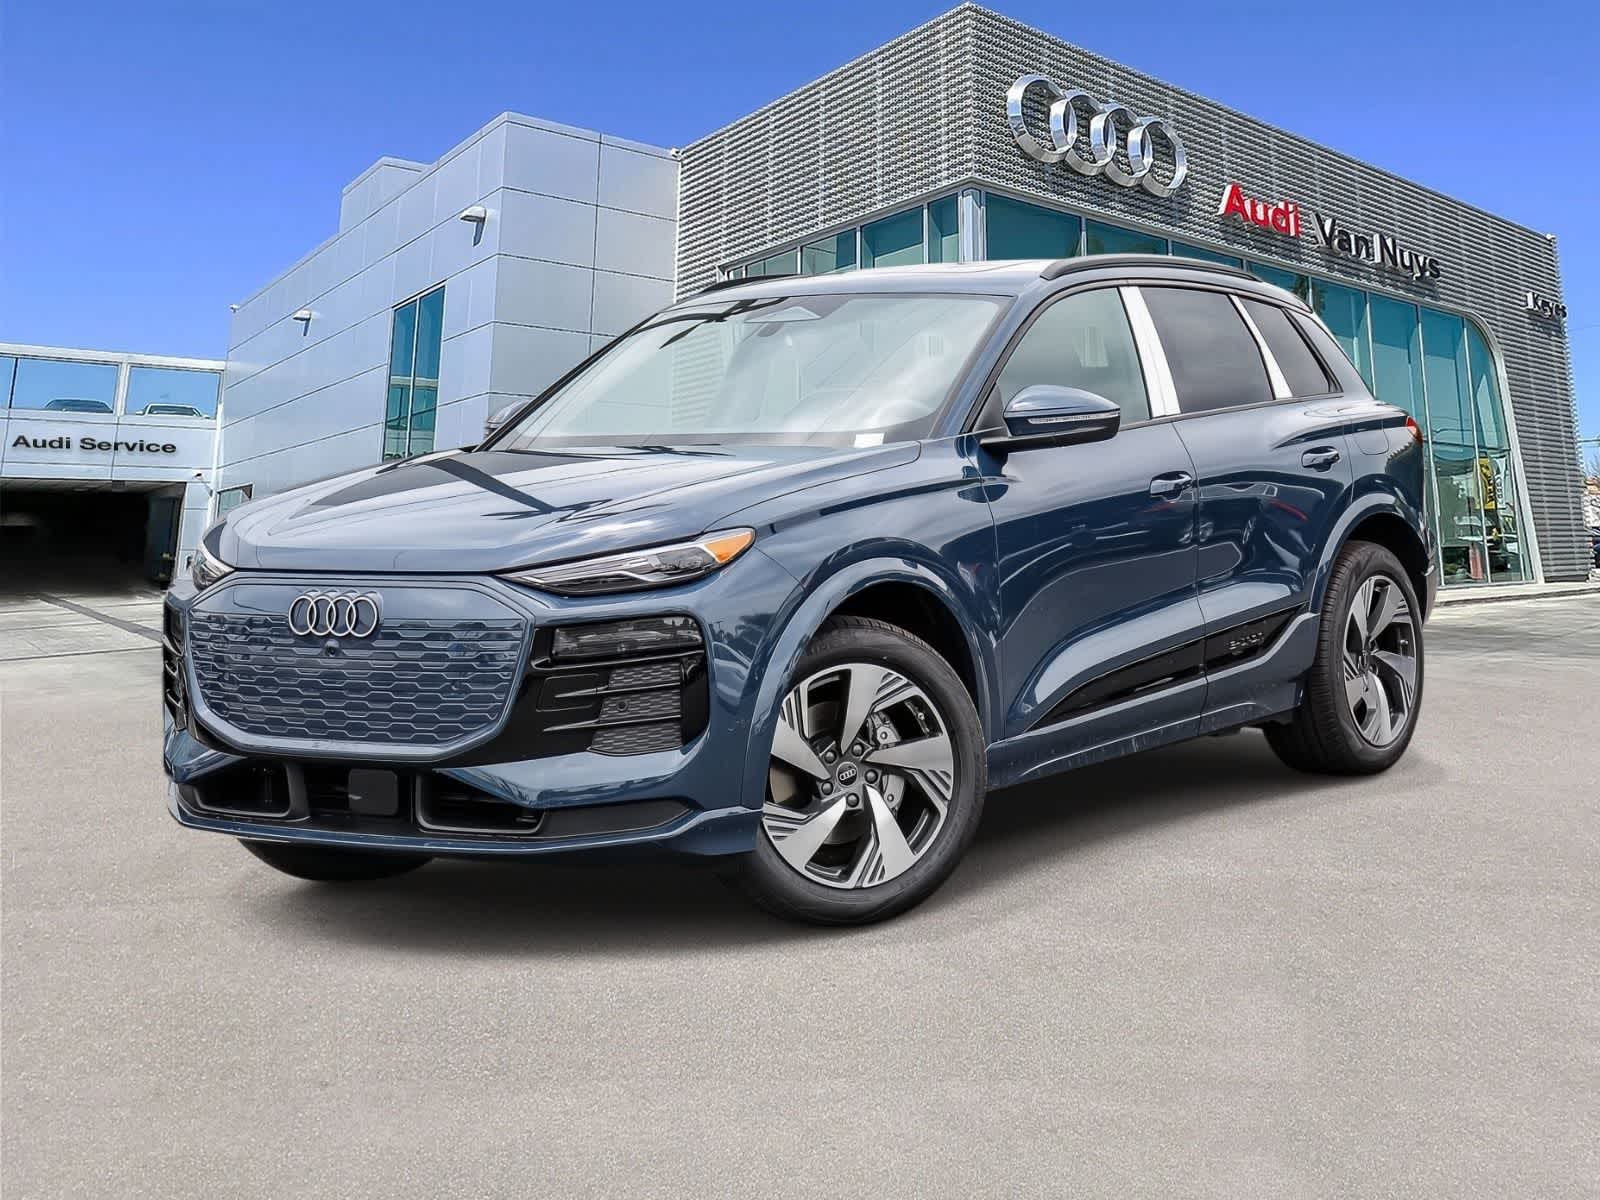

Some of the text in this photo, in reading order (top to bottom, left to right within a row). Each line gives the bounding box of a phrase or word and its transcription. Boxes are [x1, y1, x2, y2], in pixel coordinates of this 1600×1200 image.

[1218, 182, 1441, 280] Audi Van Nuys
[12, 434, 177, 454] Audi Service
